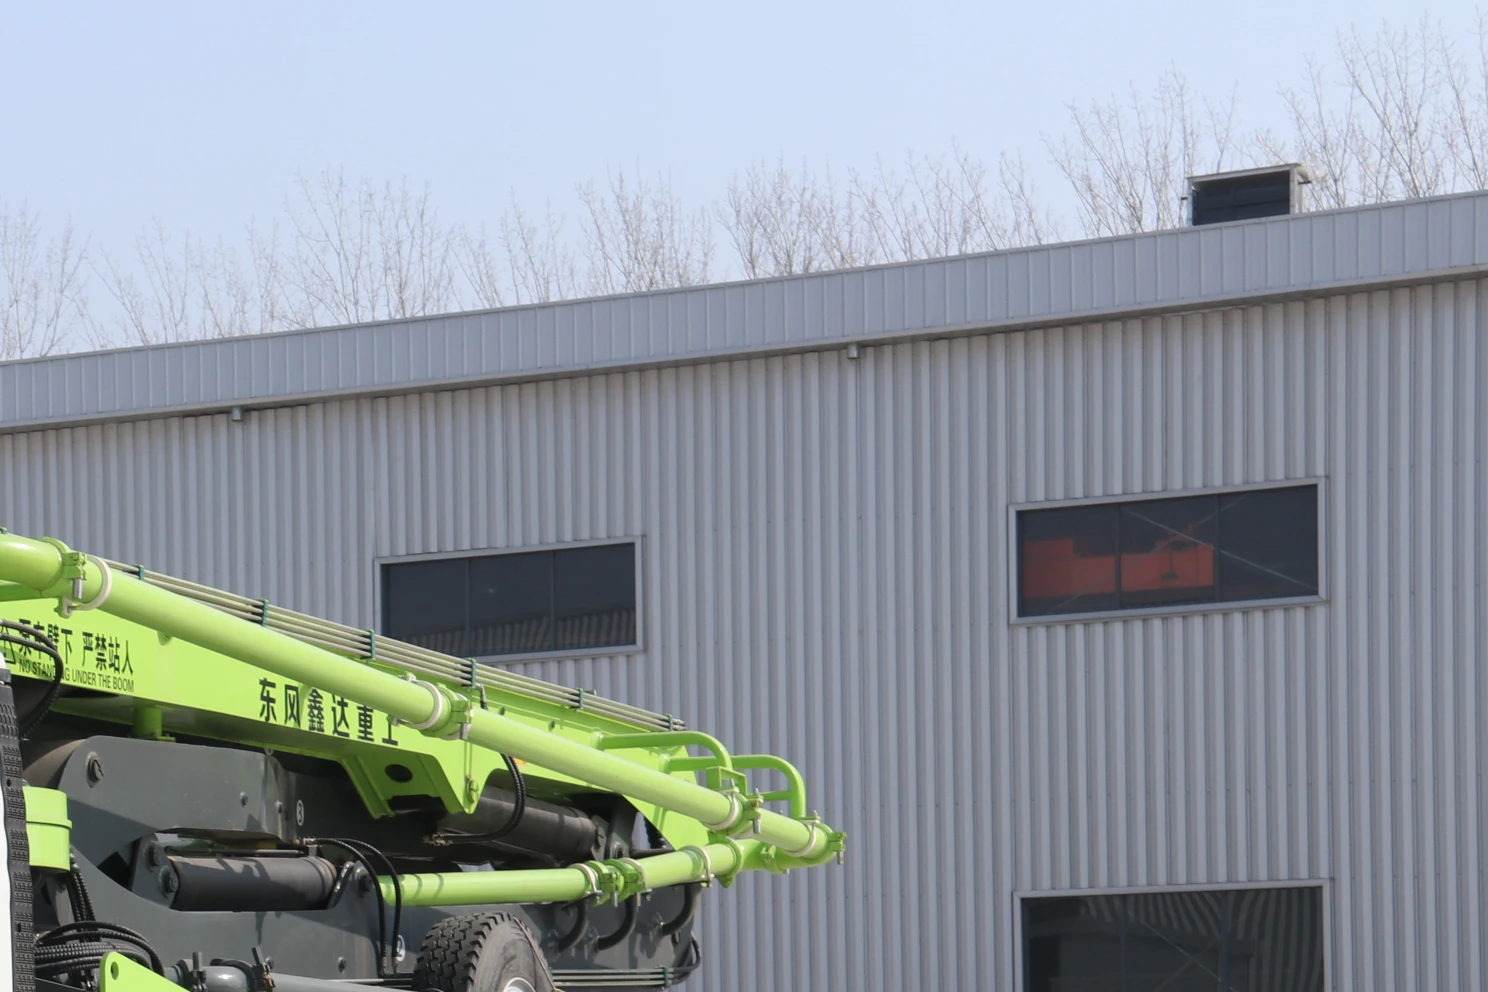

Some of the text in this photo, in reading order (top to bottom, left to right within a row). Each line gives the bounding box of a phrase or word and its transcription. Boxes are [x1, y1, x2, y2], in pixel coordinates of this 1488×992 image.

[82, 631, 134, 675] 严禁站人
[19, 658, 30, 673] NO
[72, 668, 96, 687] UNDER
[98, 674, 112, 688] THE
[113, 676, 134, 693] BOOM
[259, 677, 399, 746] 东风鑫达重工
